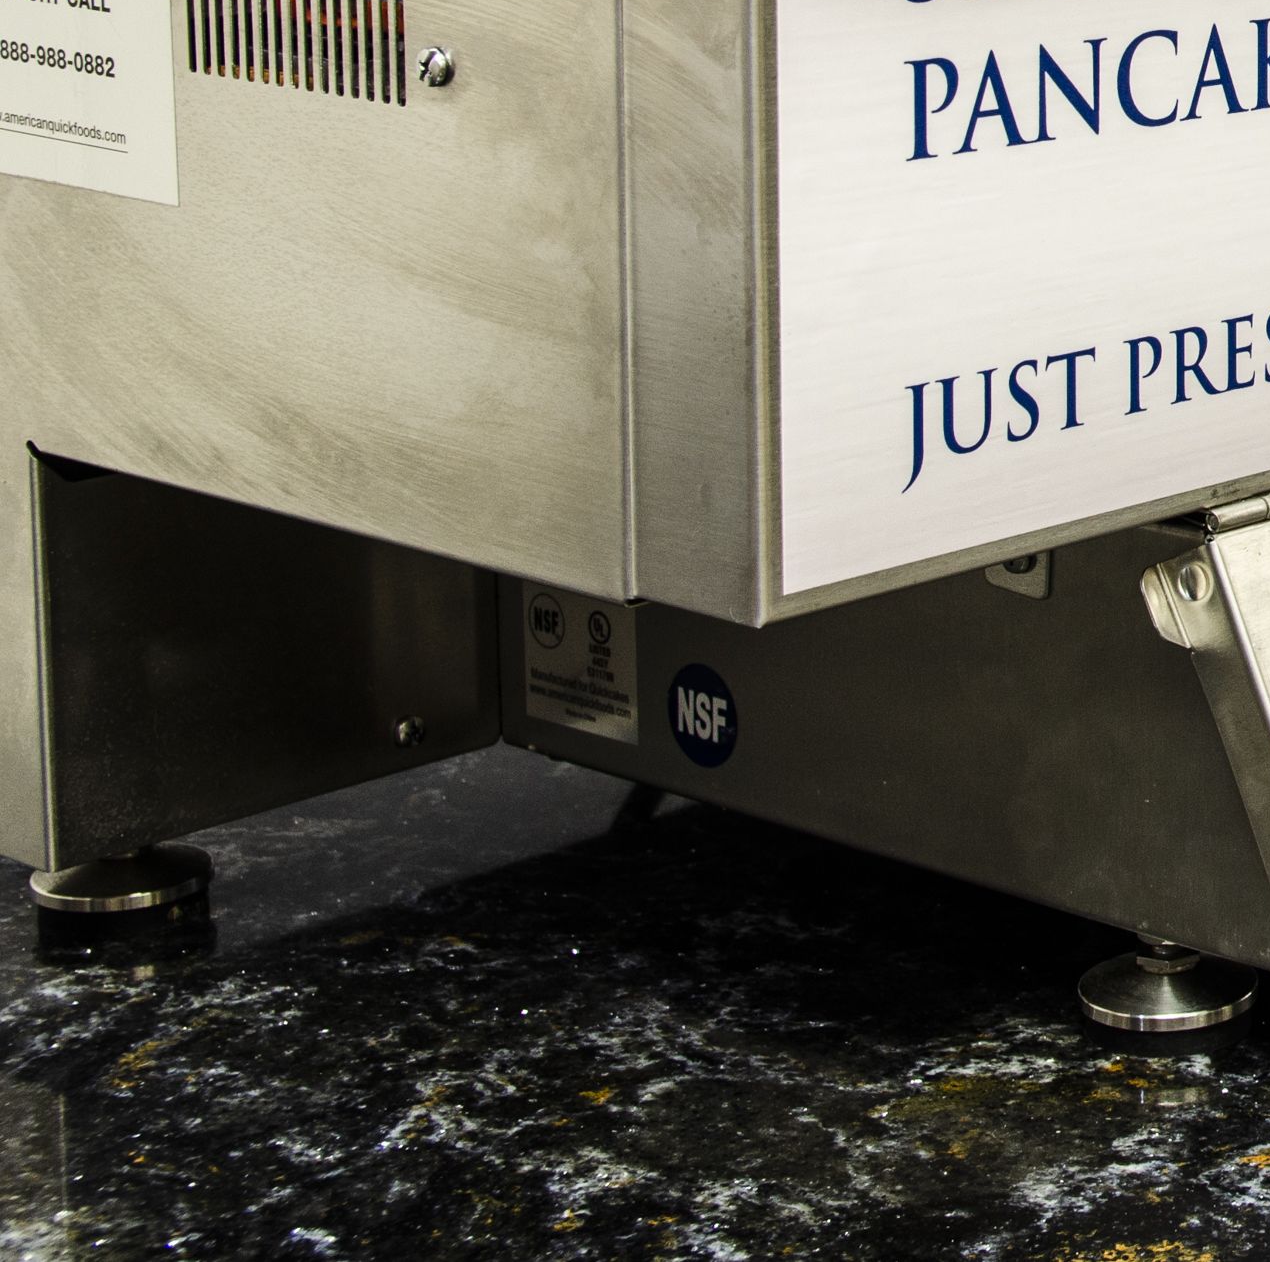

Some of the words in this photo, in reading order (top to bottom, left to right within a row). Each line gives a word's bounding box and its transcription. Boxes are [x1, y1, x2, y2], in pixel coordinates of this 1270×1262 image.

[0, 39, 116, 78] 888-988-0882
[901, 346, 1097, 494] JUST
[534, 606, 559, 636] NSF
[677, 685, 727, 744] NSF
